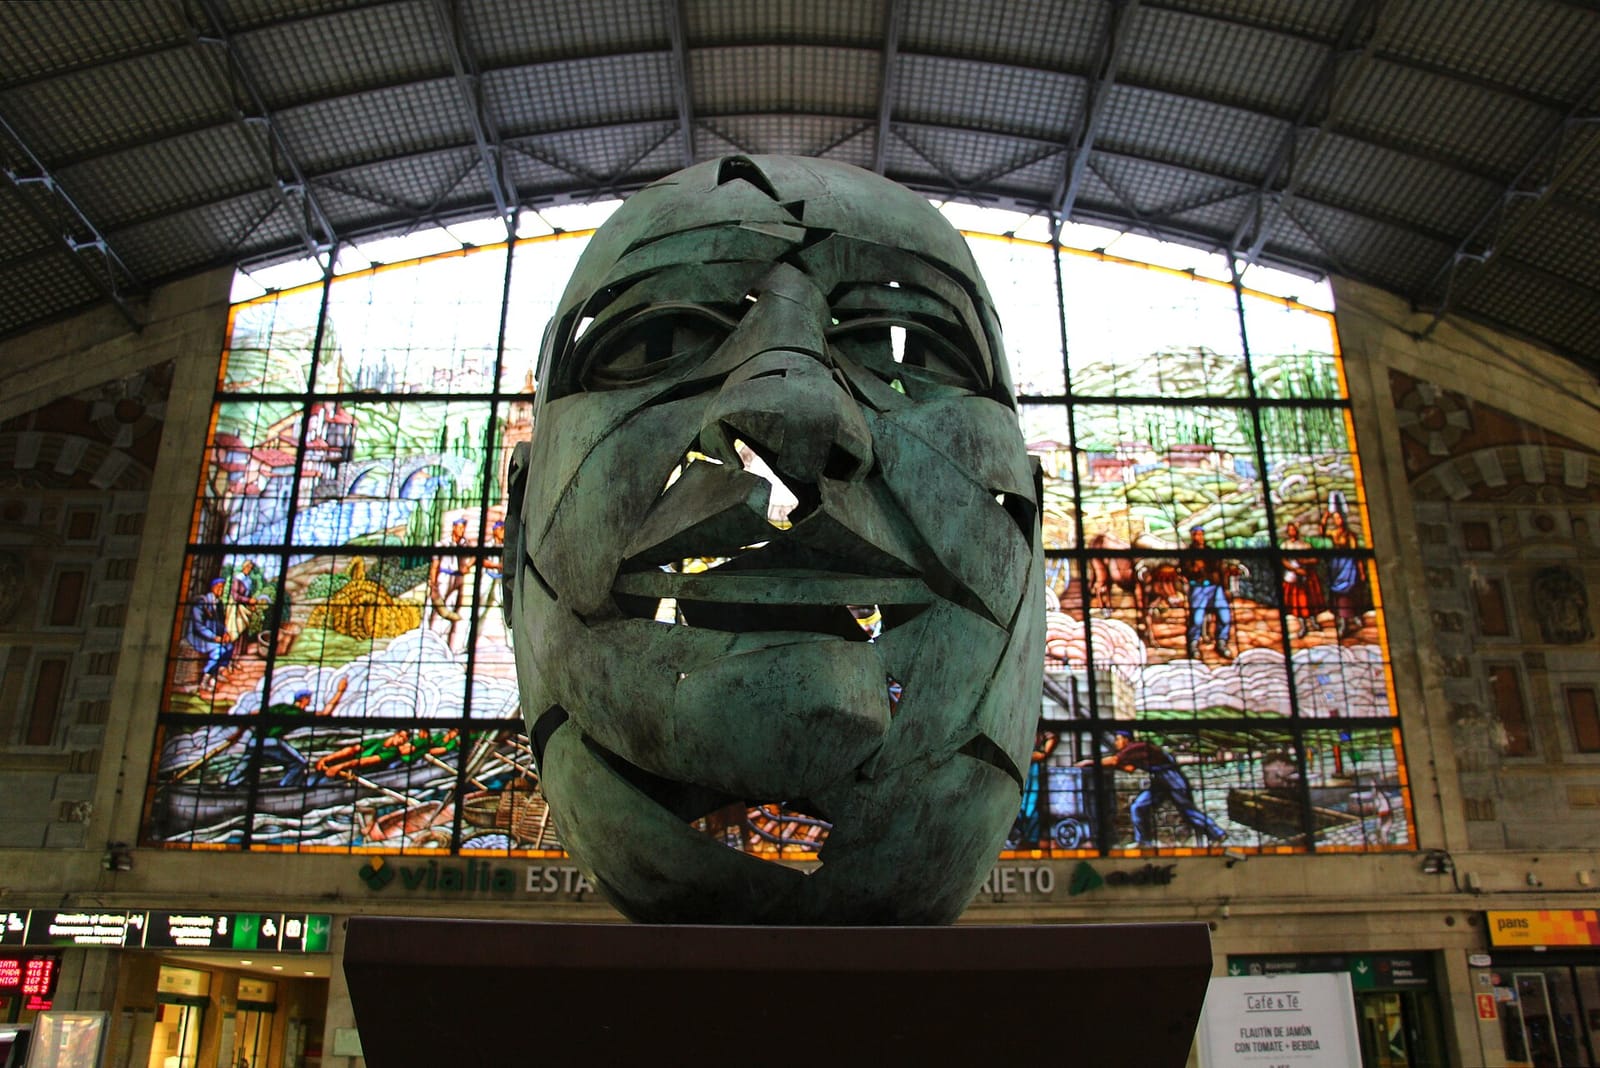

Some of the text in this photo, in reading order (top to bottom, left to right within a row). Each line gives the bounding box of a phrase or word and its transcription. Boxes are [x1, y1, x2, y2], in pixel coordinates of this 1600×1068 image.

[401, 859, 516, 893] vialia
[1498, 918, 1529, 931] pans
[1247, 995, 1273, 1009] Café
[1286, 995, 1299, 1008] Té
[1274, 1027, 1284, 1037] DE
[1286, 1024, 1312, 1037] JAMÓN
[1234, 1042, 1251, 1053] CON
[1252, 1041, 1283, 1052] TOMATE
[1291, 1040, 1320, 1051] BEBIDA
